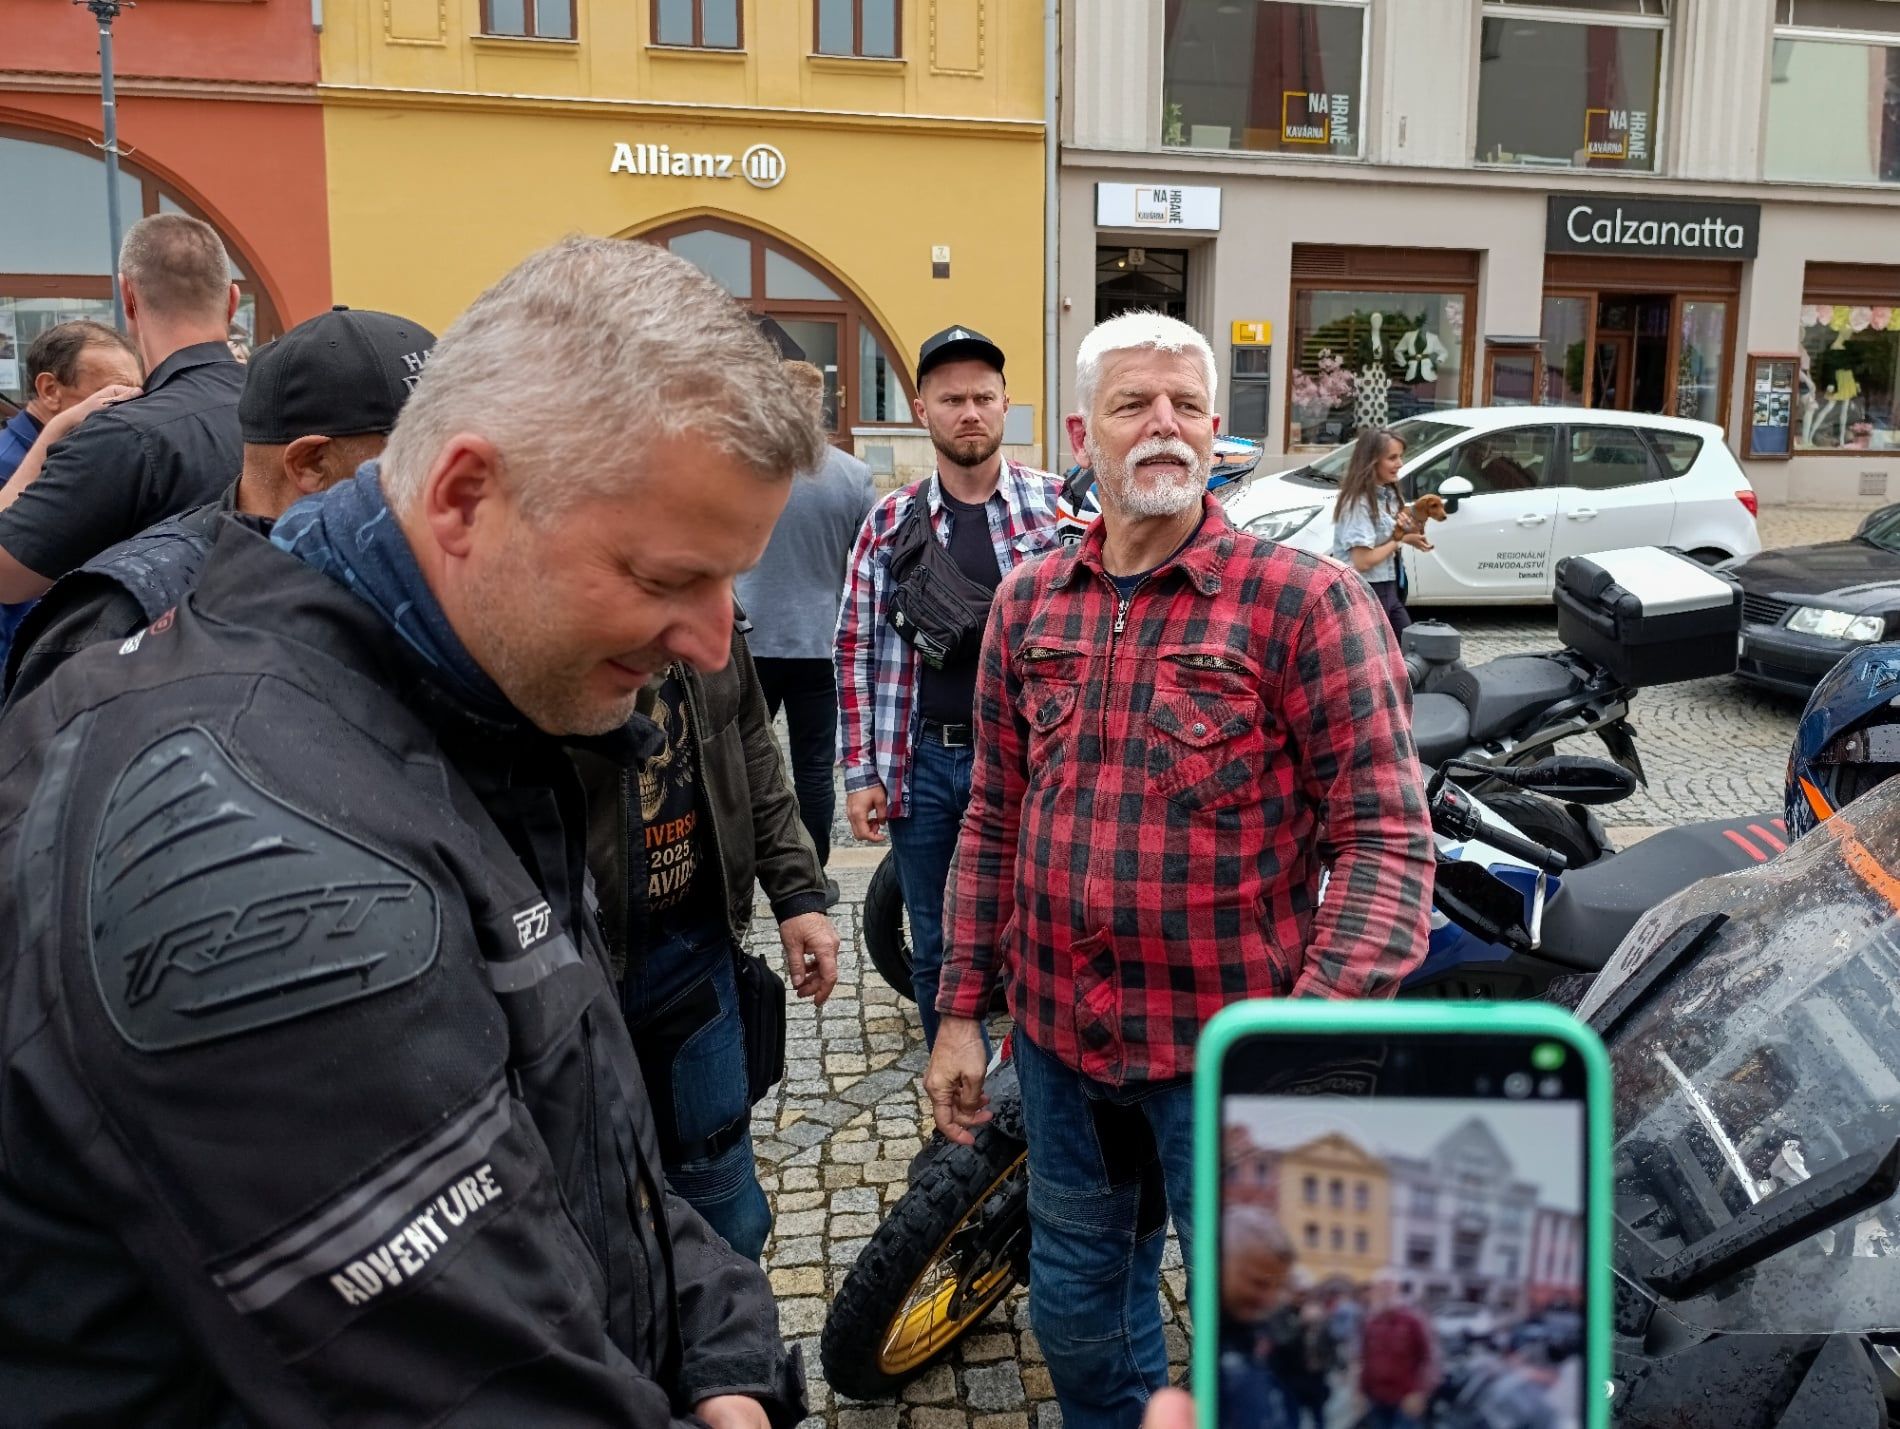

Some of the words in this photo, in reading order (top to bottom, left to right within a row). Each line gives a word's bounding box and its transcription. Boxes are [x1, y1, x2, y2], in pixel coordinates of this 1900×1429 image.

[1308, 92, 1328, 113] NA
[1286, 124, 1324, 139] KAVÁRNA
[1330, 94, 1350, 144] HRANĚ
[1609, 109, 1628, 130] NA
[1628, 111, 1648, 160] HRANĚ
[609, 142, 734, 178] Allianz
[1153, 189, 1168, 203] NA
[1169, 190, 1183, 224] HRANĚ
[1566, 205, 1745, 249] Calzanatta
[1478, 560, 1545, 570] ZPRAVODAJSTVÍ
[1496, 551, 1546, 559] REGIONÁLNÍ
[650, 839, 690, 869] 2025
[123, 878, 419, 1008] RST
[329, 1163, 503, 1306] ADVENTURE
